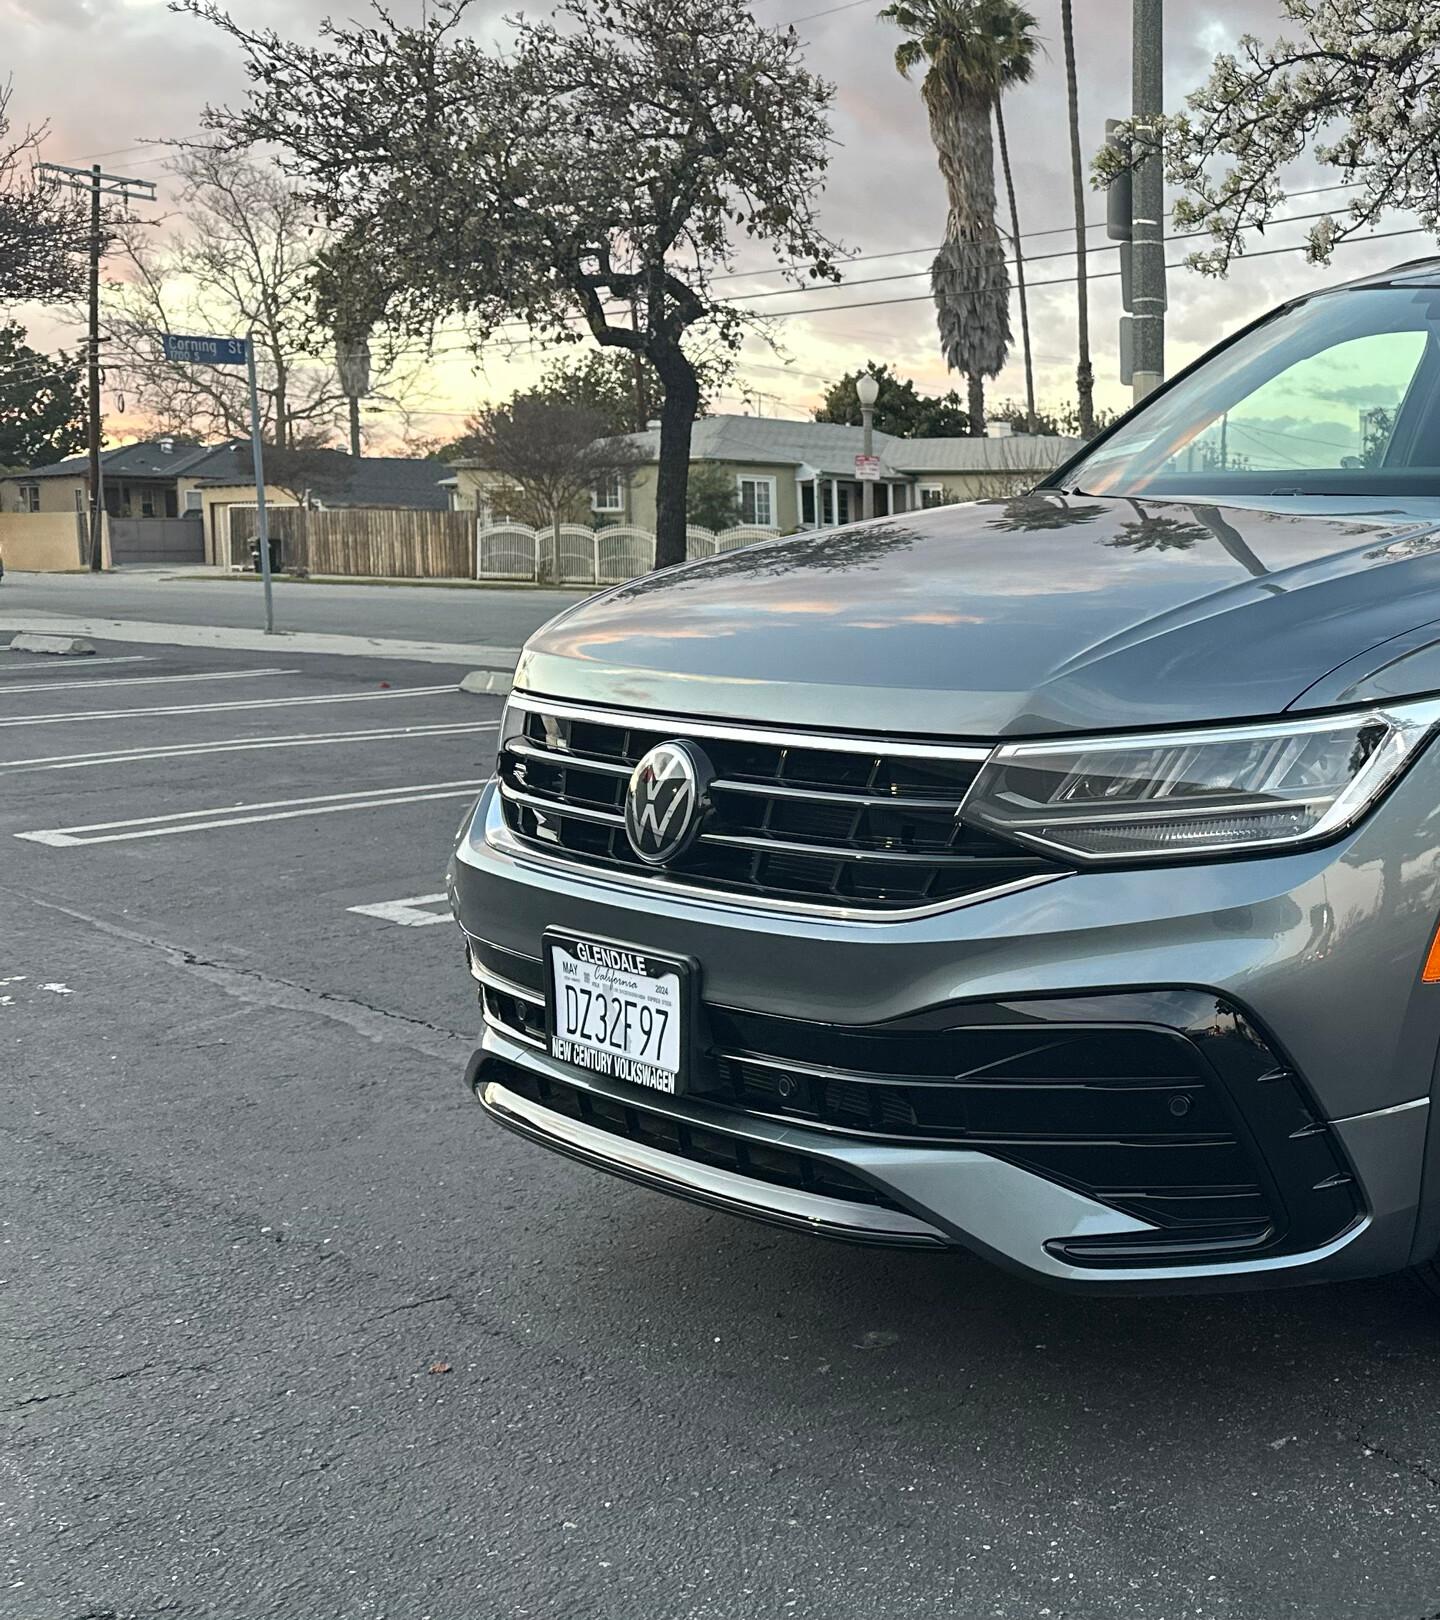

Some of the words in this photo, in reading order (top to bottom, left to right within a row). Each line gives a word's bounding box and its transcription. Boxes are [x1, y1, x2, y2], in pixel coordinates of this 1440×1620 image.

[168, 336, 217, 356] Corning
[228, 340, 242, 354] St
[562, 961, 578, 976] MAY
[576, 942, 647, 976] GLENDALE
[593, 965, 638, 991] California
[655, 984, 669, 996] 2024
[565, 984, 669, 1061] DZ32F97
[552, 1036, 571, 1060] NEW
[573, 1044, 612, 1075] CENTURY
[614, 1056, 675, 1095] VOLKSWAGEN
